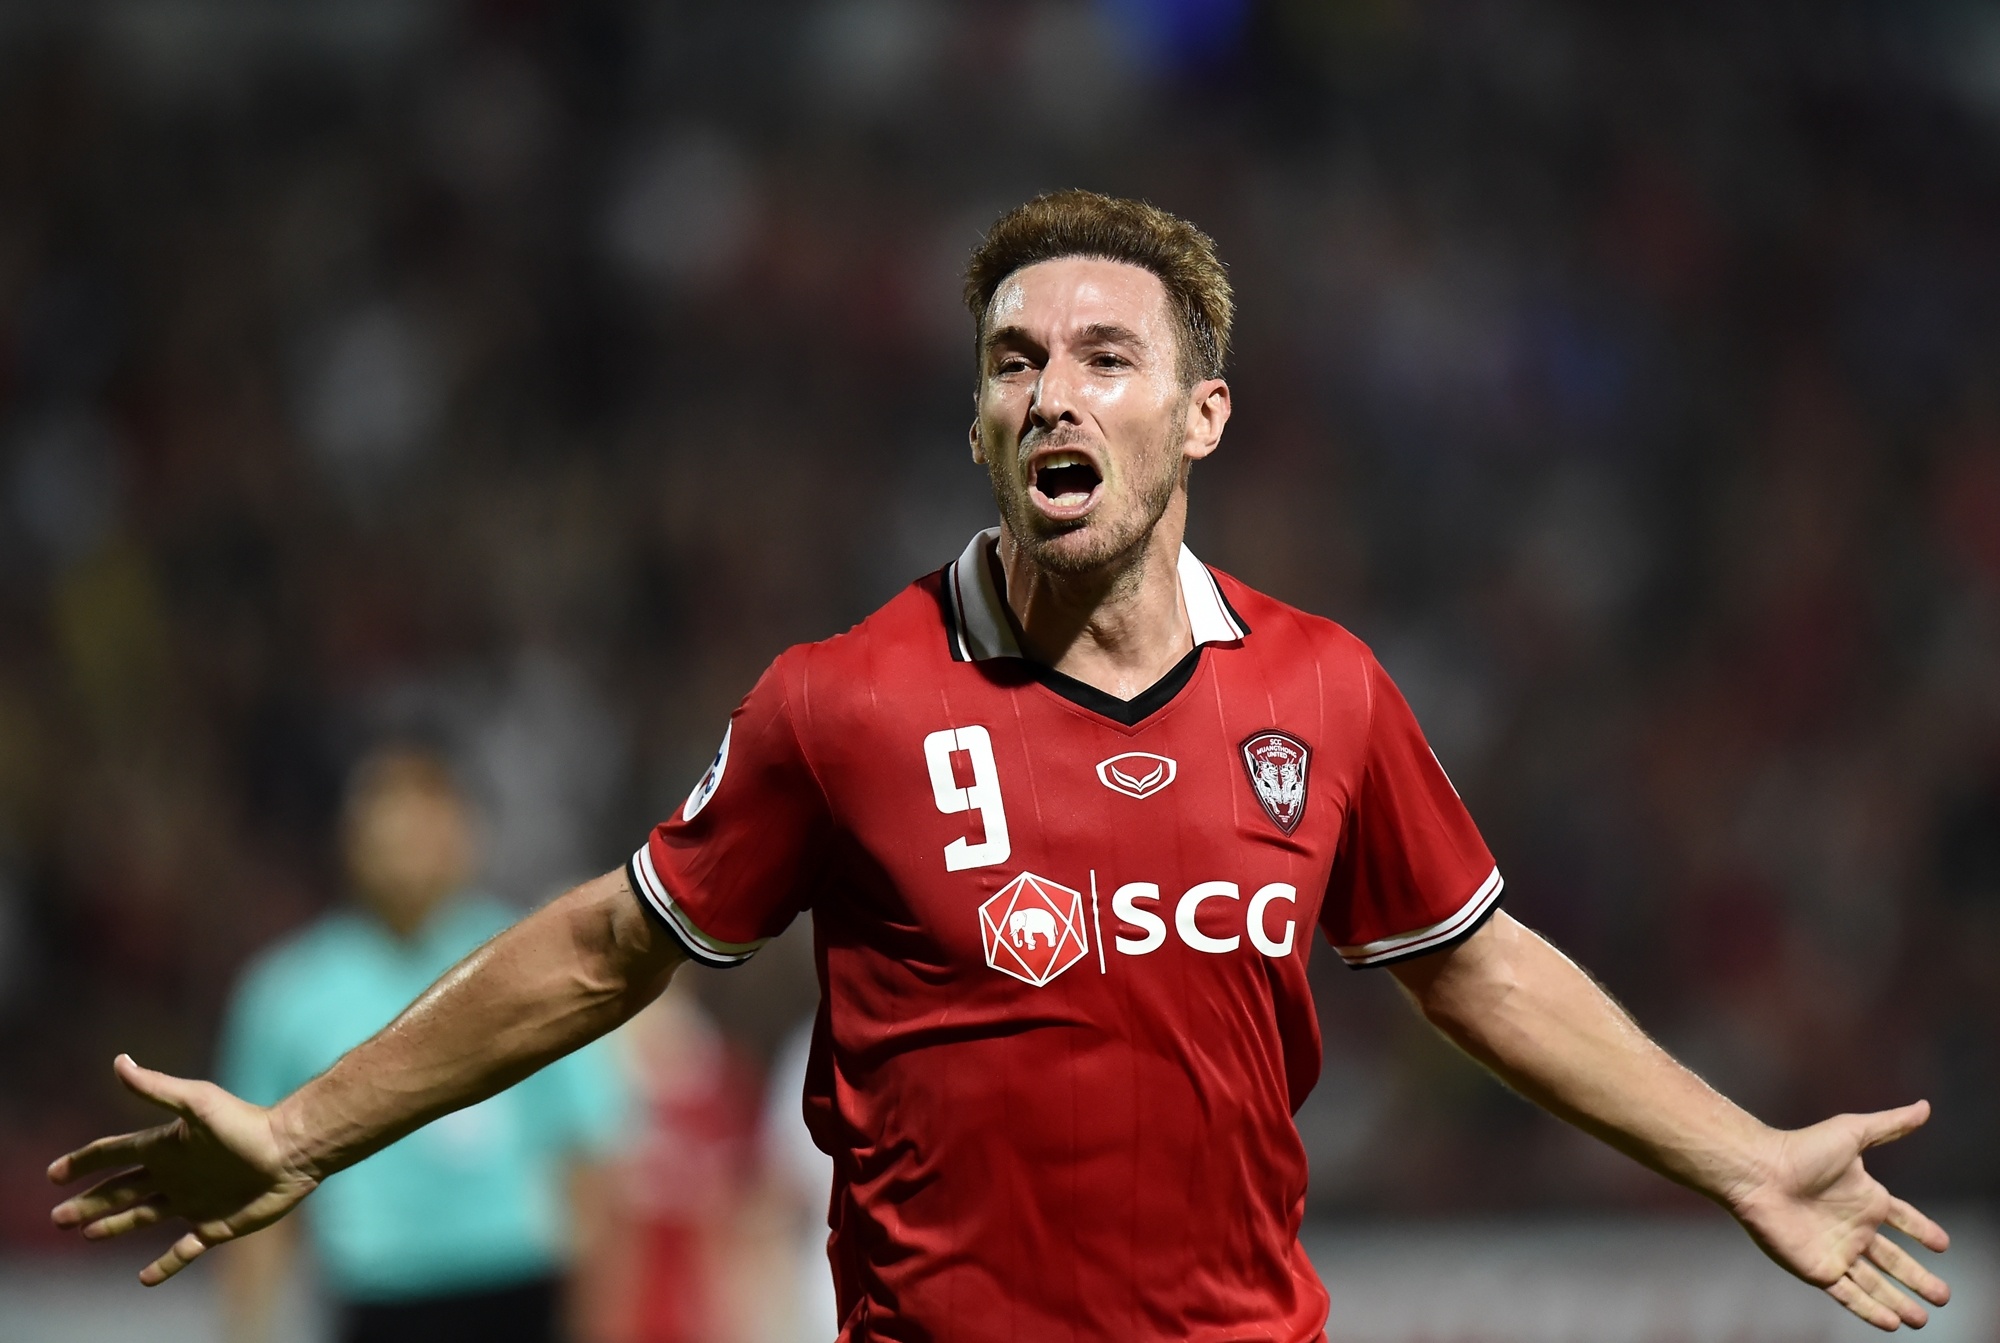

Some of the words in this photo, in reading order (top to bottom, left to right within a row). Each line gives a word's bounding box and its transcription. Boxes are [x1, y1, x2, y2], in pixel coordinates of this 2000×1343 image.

[1269, 738, 1282, 746] SCG
[1256, 745, 1297, 758] MUANGTHONG
[1267, 751, 1288, 759] UNITED
[923, 725, 1011, 872] 9
[1111, 881, 1297, 958] SCG
